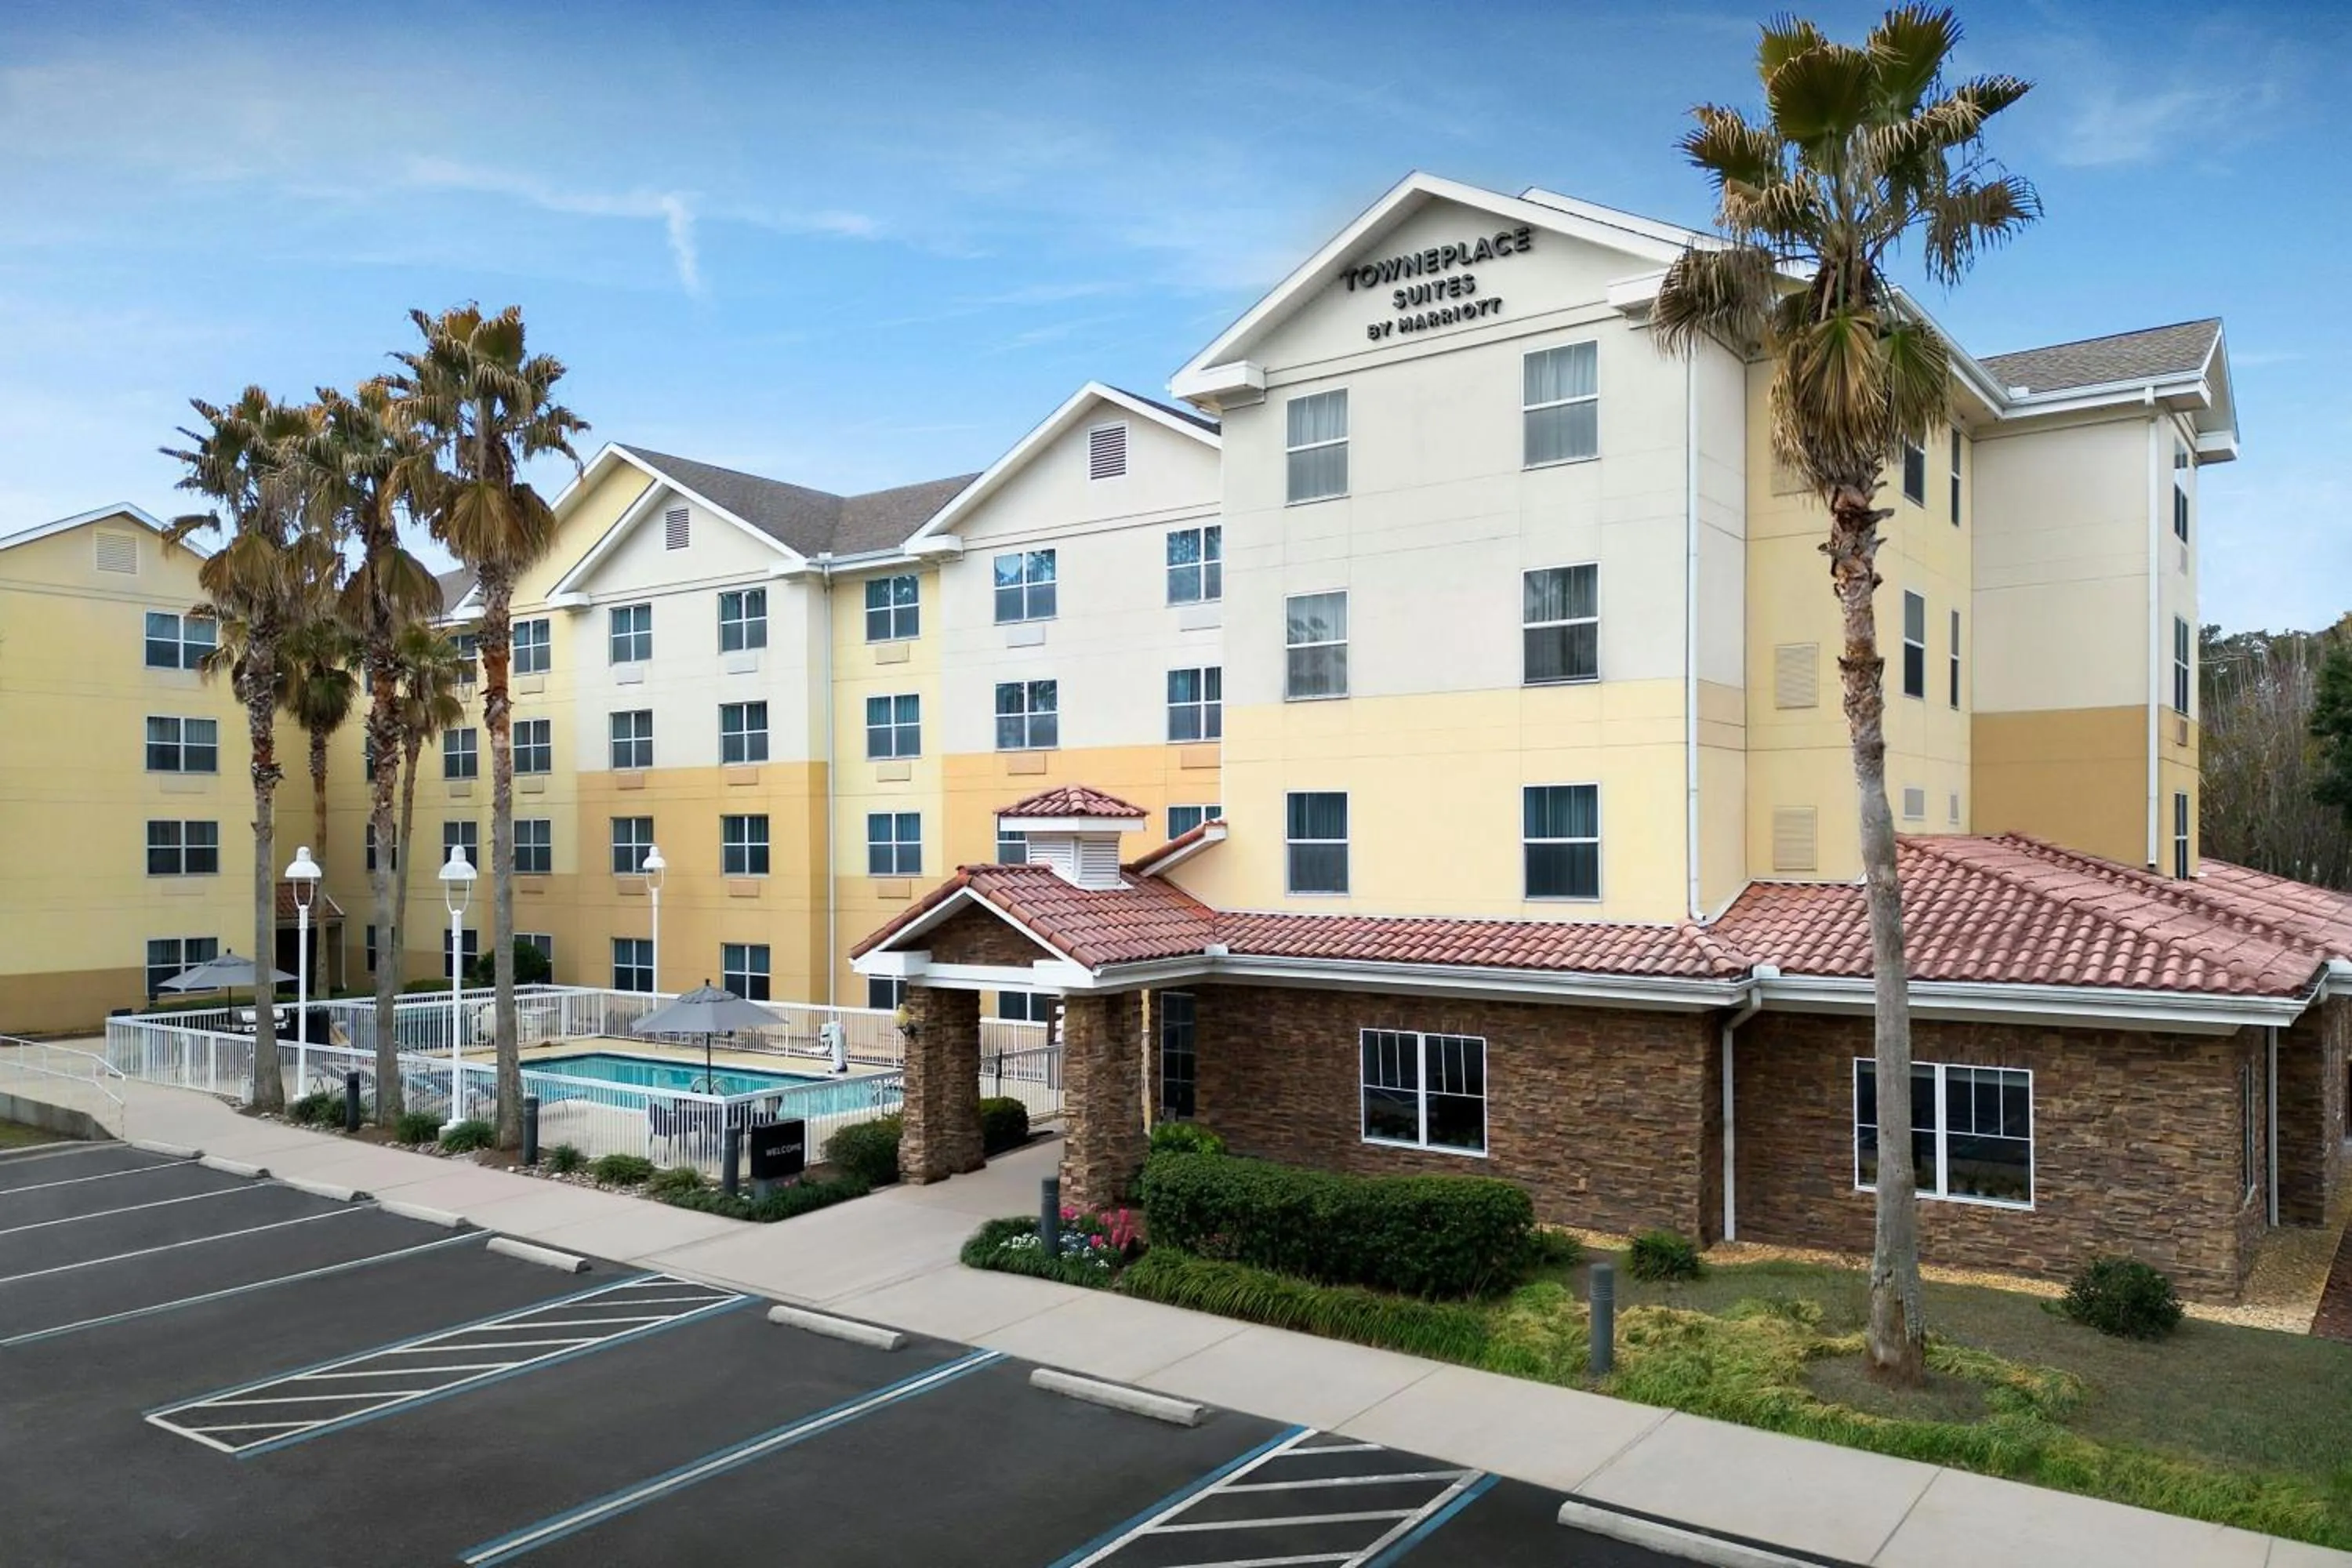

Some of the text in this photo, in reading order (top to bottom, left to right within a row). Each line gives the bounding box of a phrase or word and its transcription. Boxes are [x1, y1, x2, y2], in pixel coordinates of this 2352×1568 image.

[1341, 227, 1532, 291] TOWNEPLACE
[1393, 274, 1475, 309] SUITES
[1367, 298, 1502, 340] BY MARRIOTT
[765, 1143, 801, 1157] WELCOME
